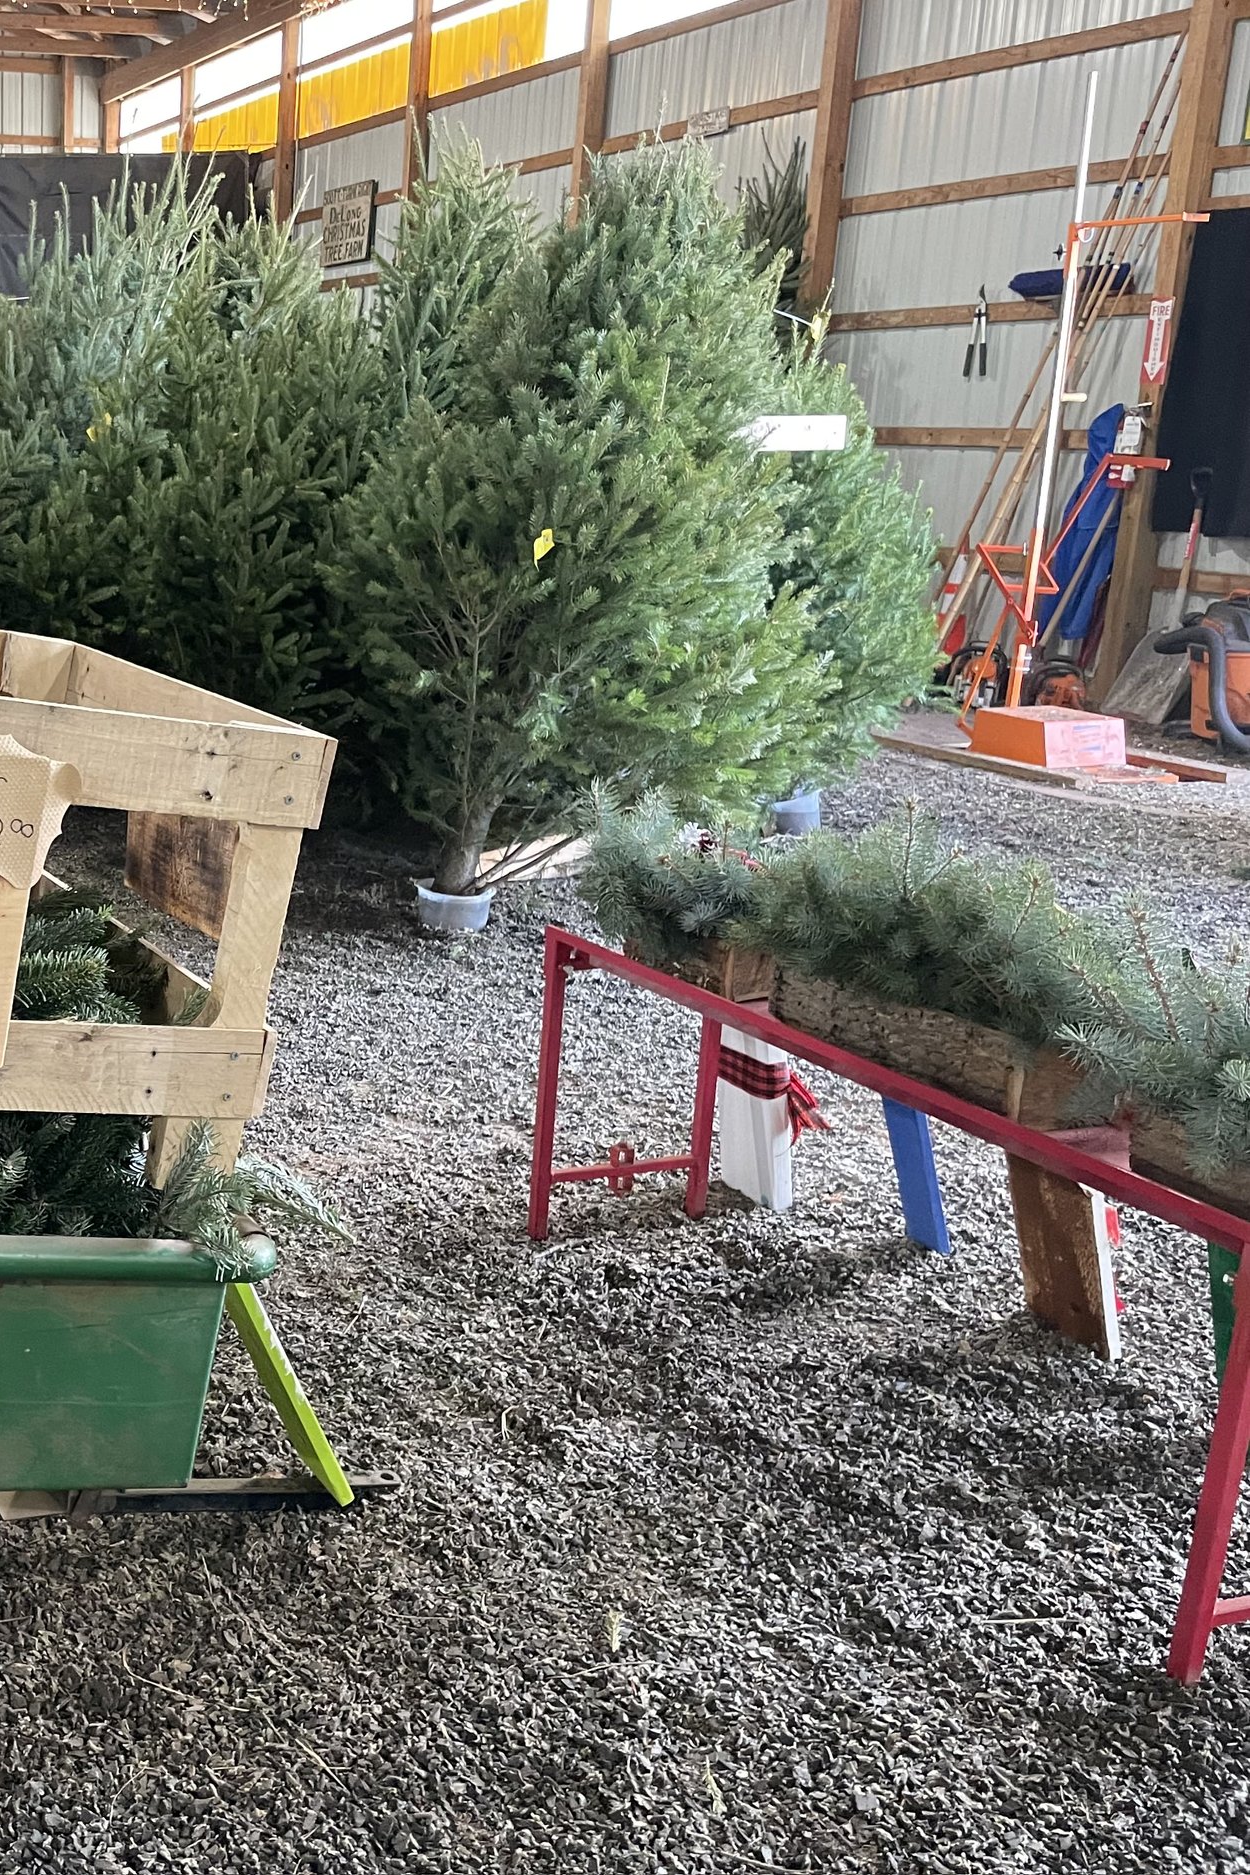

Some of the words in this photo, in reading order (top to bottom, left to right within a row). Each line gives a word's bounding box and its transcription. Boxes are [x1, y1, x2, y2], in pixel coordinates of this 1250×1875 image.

[323, 218, 366, 244] CHRISTMAS
[325, 243, 343, 262] TREE
[344, 239, 364, 260] FARM
[1152, 305, 1170, 316] FIRE
